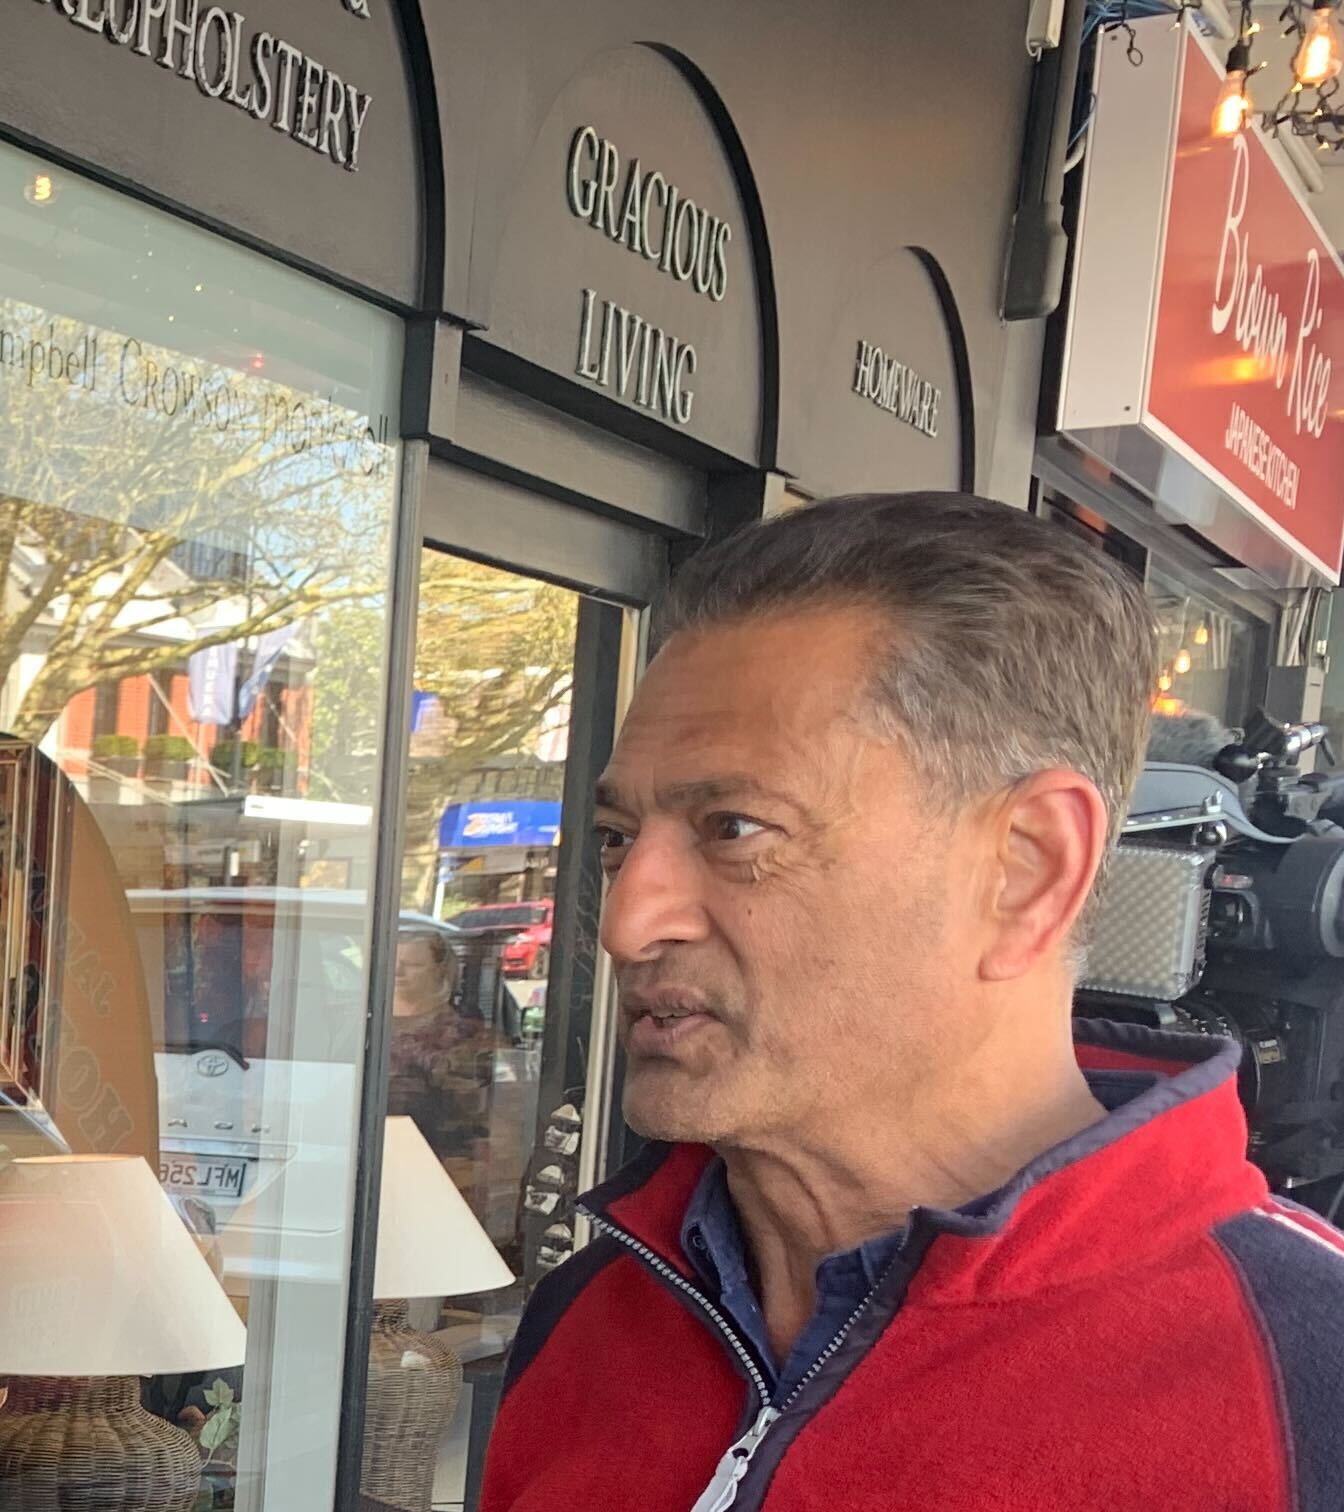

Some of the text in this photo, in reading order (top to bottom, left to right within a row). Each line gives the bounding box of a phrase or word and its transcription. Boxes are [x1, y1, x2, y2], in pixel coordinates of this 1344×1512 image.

[24, 0, 373, 172] UPHOLSTERY
[568, 126, 732, 302] GRACIOUS
[1212, 133, 1333, 439] Brown Rice
[576, 288, 697, 424] LIVING
[852, 339, 942, 438] HOMEWARE
[1225, 401, 1300, 510] JAPANESE KITCHEN
